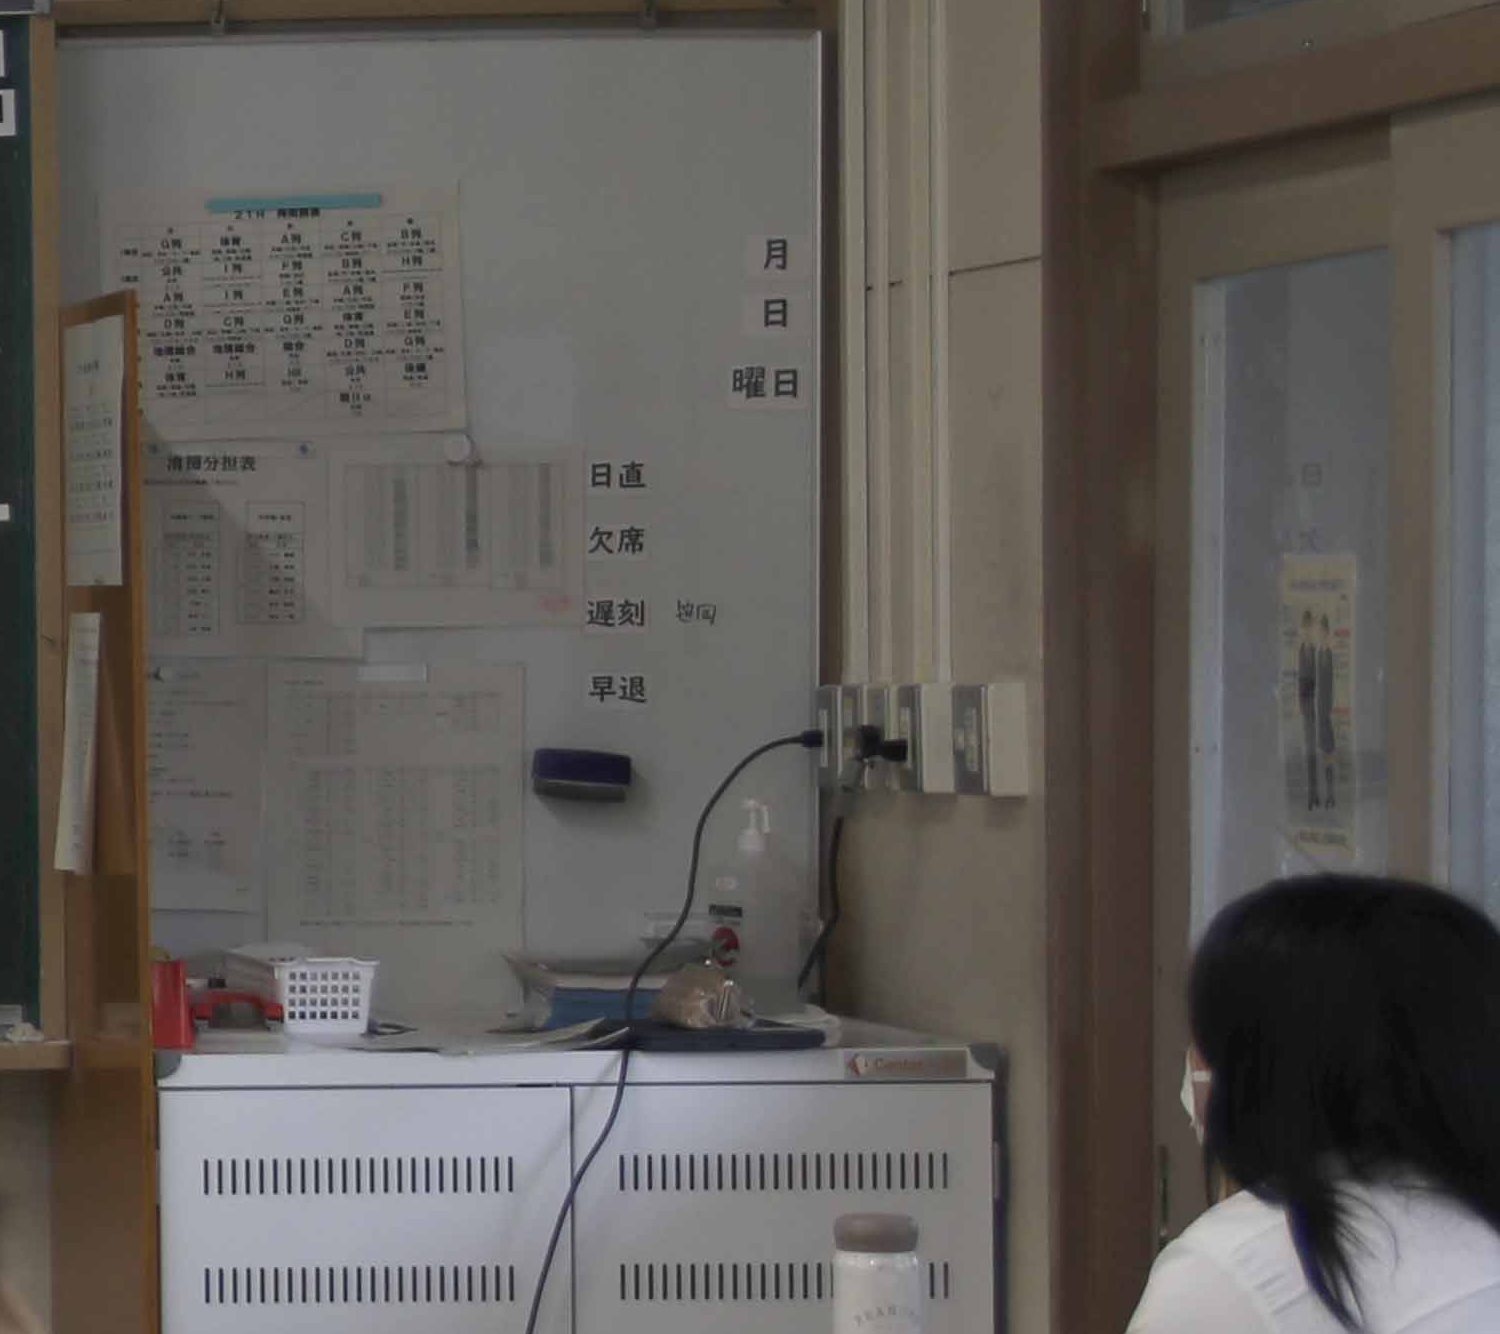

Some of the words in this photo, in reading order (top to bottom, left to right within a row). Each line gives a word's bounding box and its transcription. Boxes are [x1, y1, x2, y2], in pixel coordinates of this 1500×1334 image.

[762, 239, 789, 271] 月
[764, 297, 787, 328] 日
[731, 367, 800, 399] 曜日
[590, 460, 647, 489] 日直
[588, 525, 645, 555] 欠席
[587, 599, 646, 628] 遅刻
[588, 675, 647, 704] 早退
